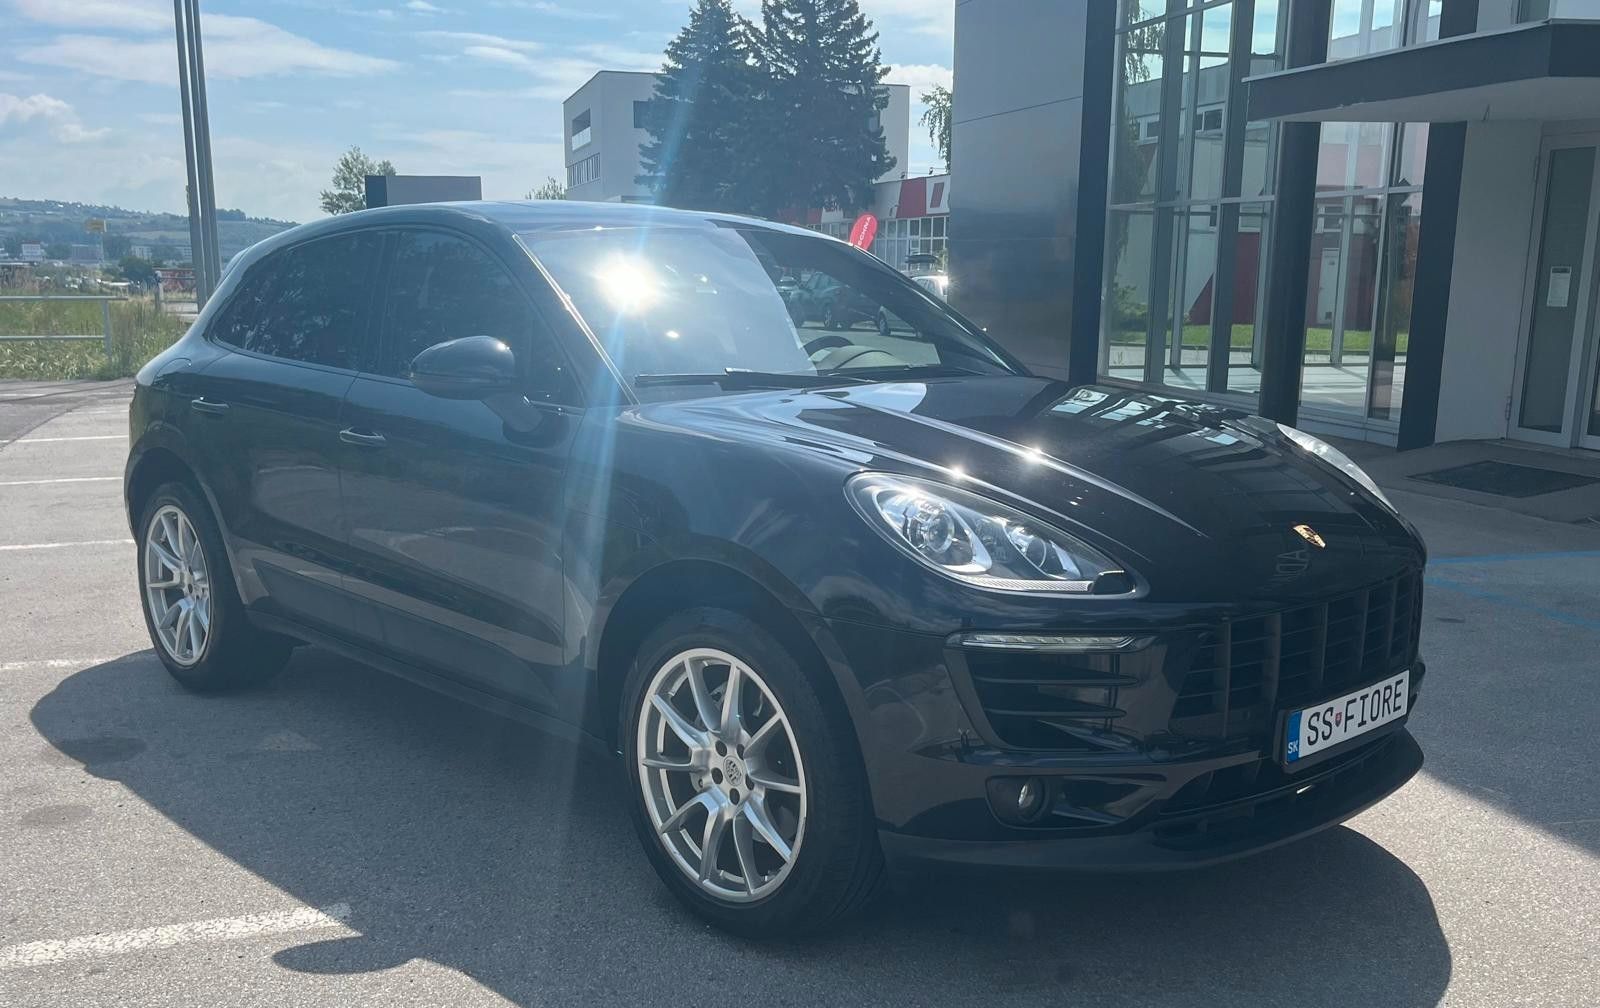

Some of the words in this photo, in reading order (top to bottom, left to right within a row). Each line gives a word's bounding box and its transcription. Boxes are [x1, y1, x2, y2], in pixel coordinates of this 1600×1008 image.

[1307, 706, 1334, 746] SS
[1344, 679, 1404, 733] FIORE
[1287, 739, 1299, 754] SK
